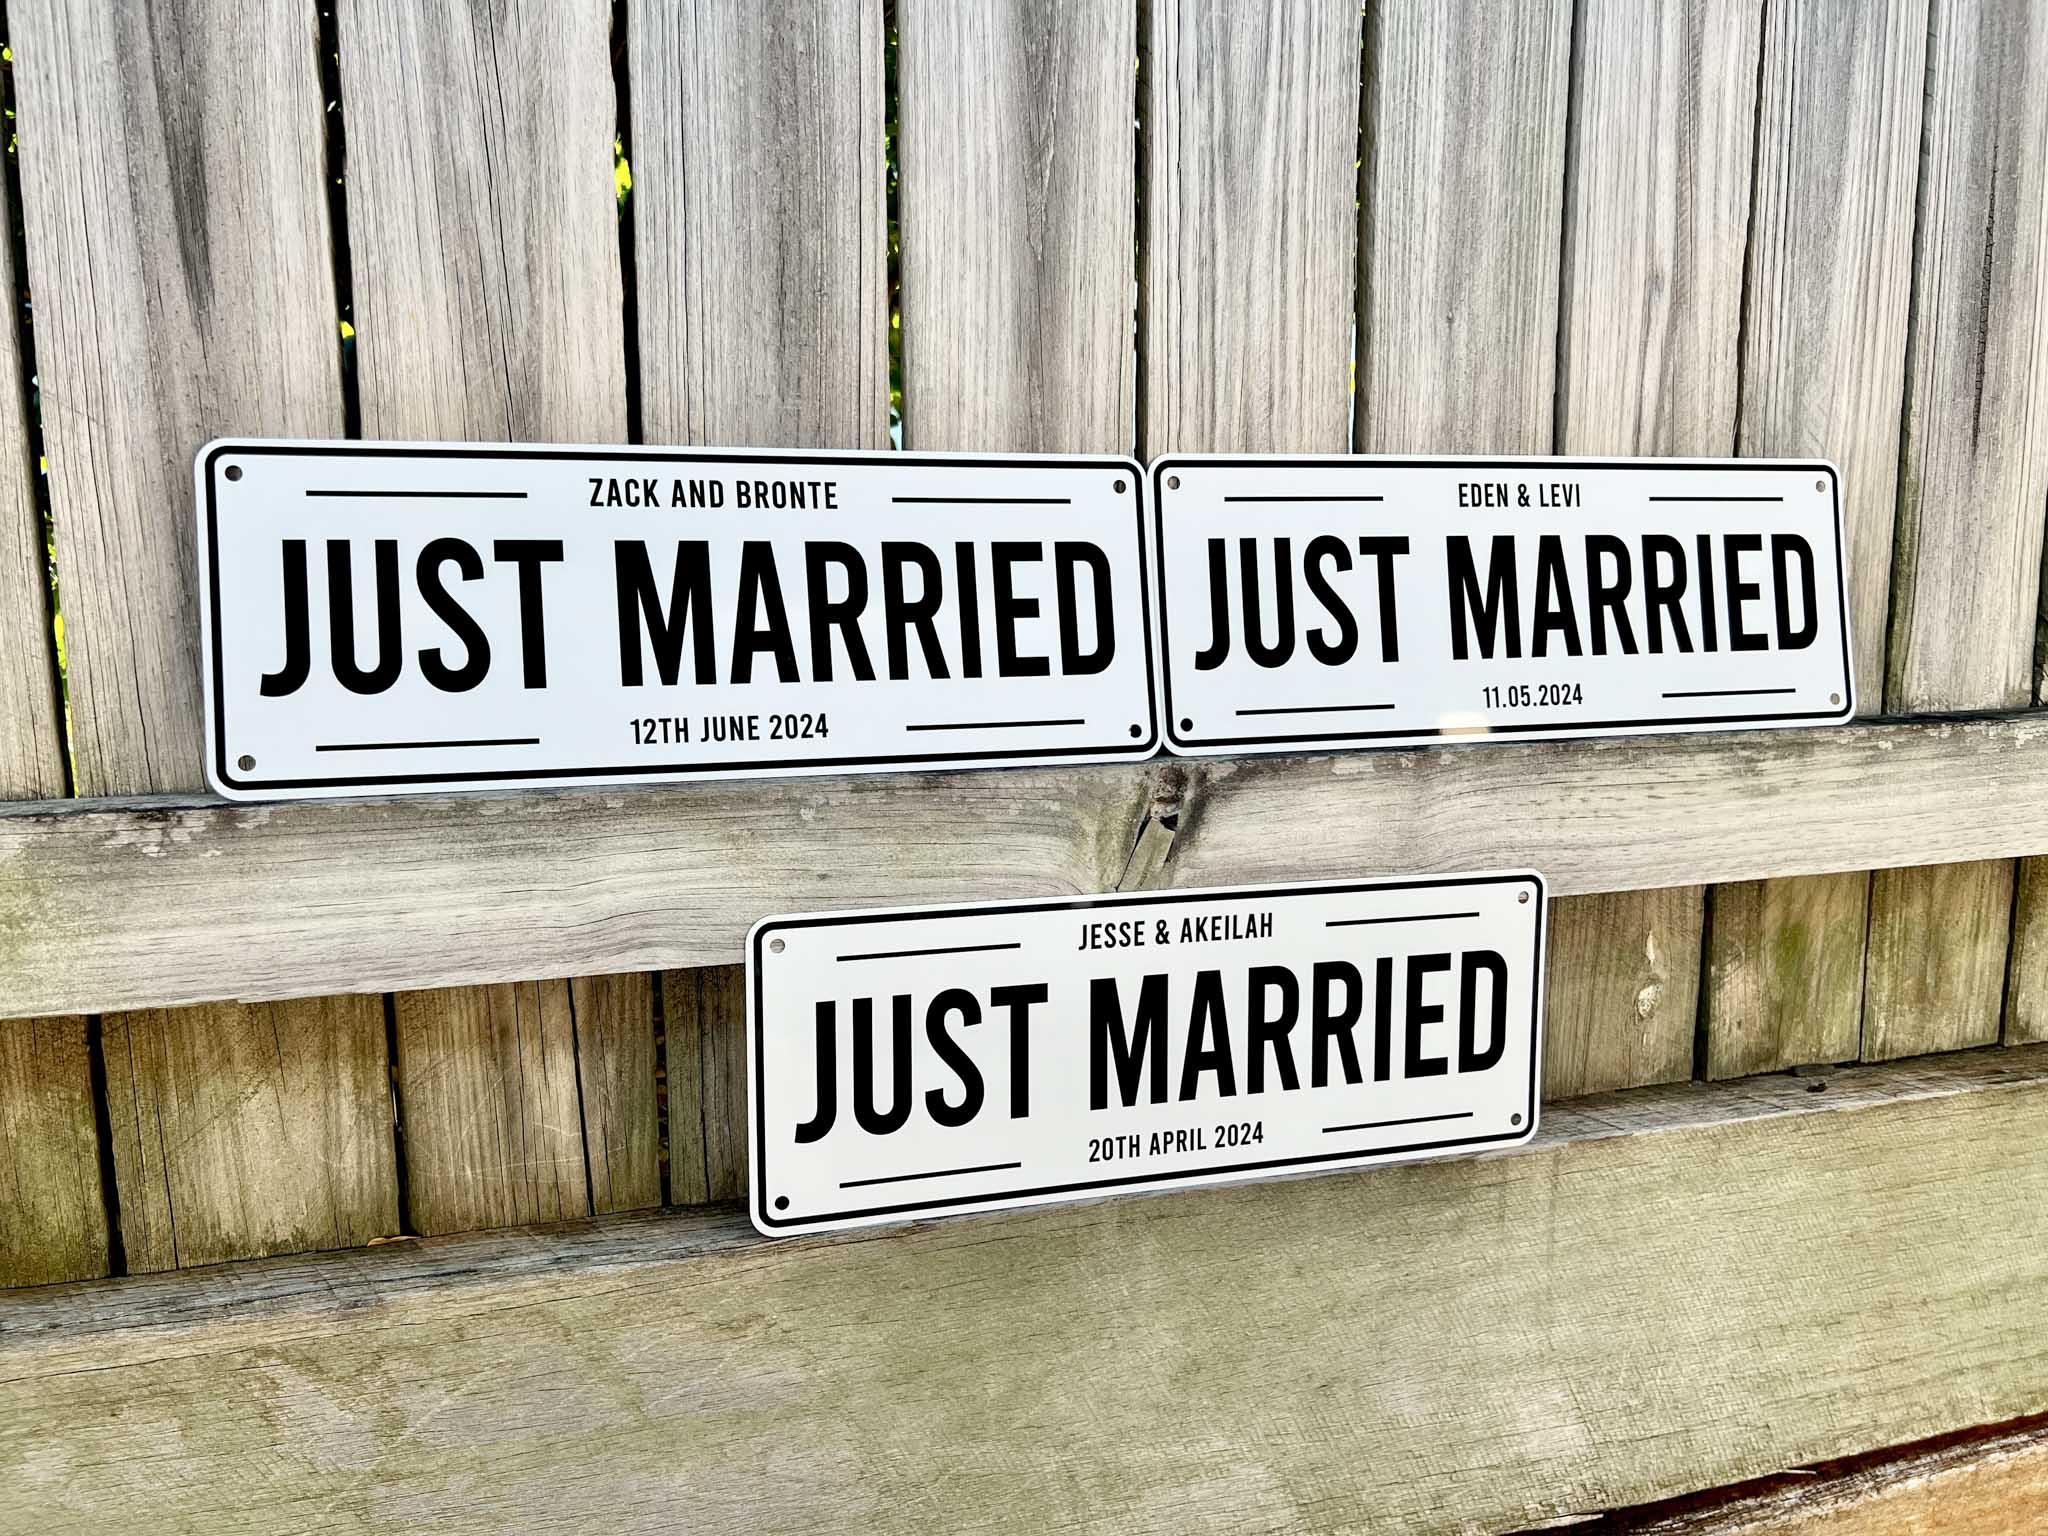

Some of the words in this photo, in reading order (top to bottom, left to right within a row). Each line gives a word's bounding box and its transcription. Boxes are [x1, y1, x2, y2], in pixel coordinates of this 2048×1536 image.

[588, 478, 660, 508] ZACK
[671, 479, 724, 508] AND
[735, 480, 838, 510] BRONTE
[1458, 483, 1509, 508] EDEN
[1517, 483, 1531, 508] &
[1539, 483, 1581, 508] LEVI
[259, 537, 565, 698] JUST
[614, 539, 1116, 687] MARRIED
[1194, 534, 1410, 671] JUST
[1446, 533, 1818, 661] MARRIED
[1482, 683, 1583, 709] 11.05.2024
[629, 717, 689, 745] 12TH
[700, 715, 760, 743] JUNE
[769, 713, 829, 740] 2024
[1078, 920, 1145, 951] JESSE
[1155, 919, 1170, 945] &
[1179, 912, 1273, 944] AKEILAH
[794, 982, 1049, 1144] JUST
[1089, 949, 1508, 1111] MARRIED
[1088, 1134, 1140, 1163] 20TH
[1149, 1127, 1207, 1156] APRIL
[1214, 1121, 1264, 1149] 2024
